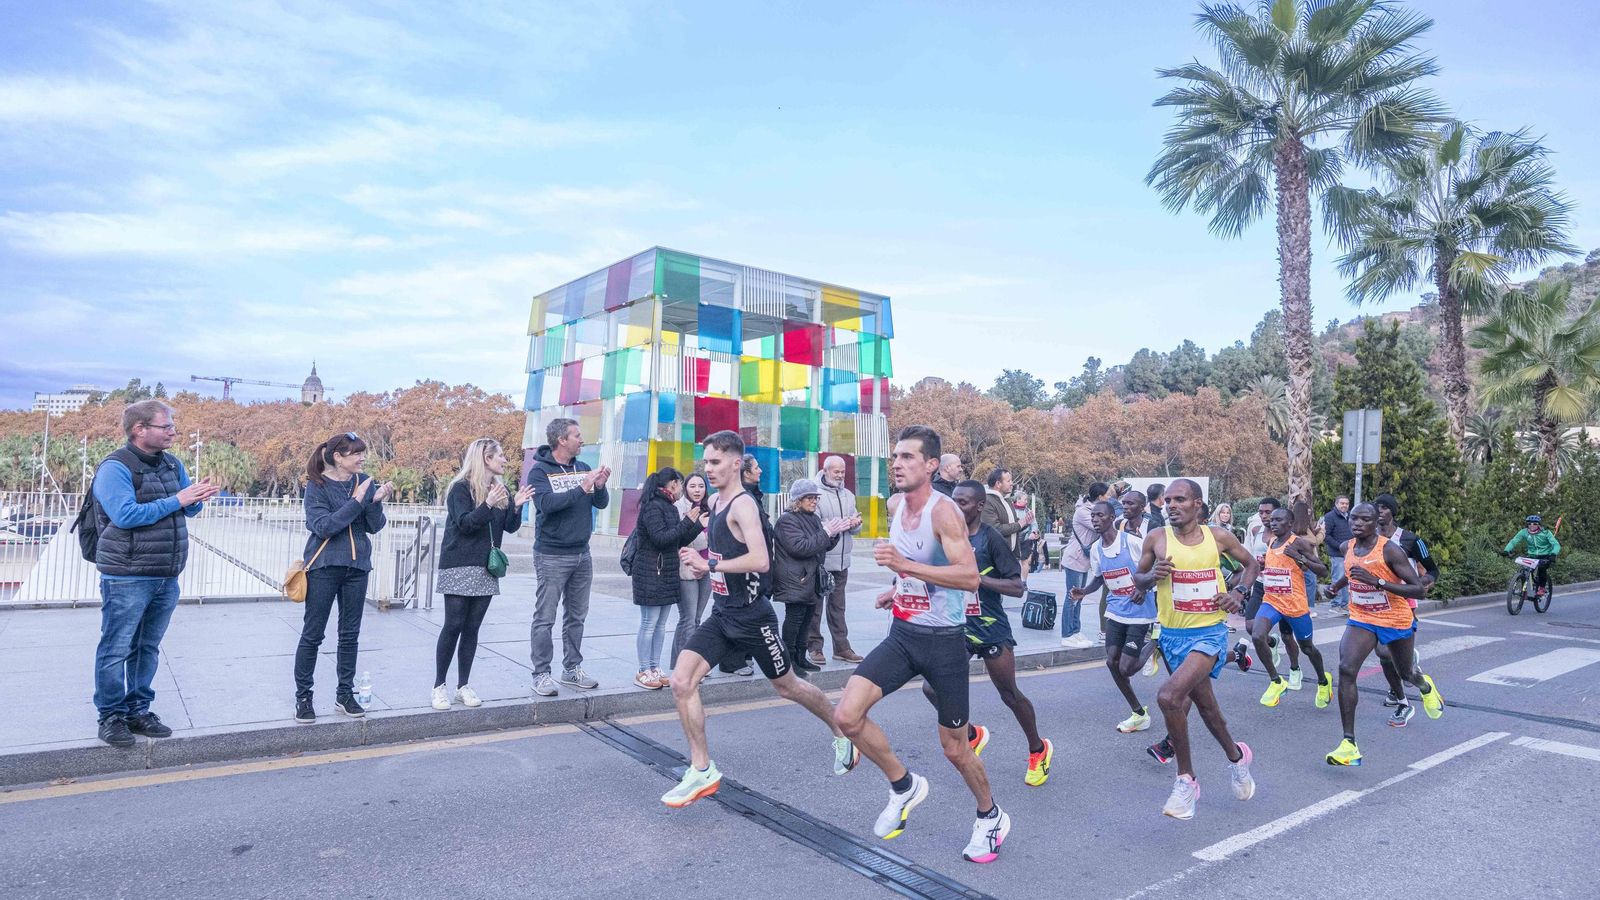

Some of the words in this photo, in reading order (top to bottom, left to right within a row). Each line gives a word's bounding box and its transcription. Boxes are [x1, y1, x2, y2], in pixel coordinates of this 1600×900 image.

[1182, 570, 1214, 579] GENERALI
[760, 625, 776, 645] 247
[768, 642, 786, 676] TEAM
